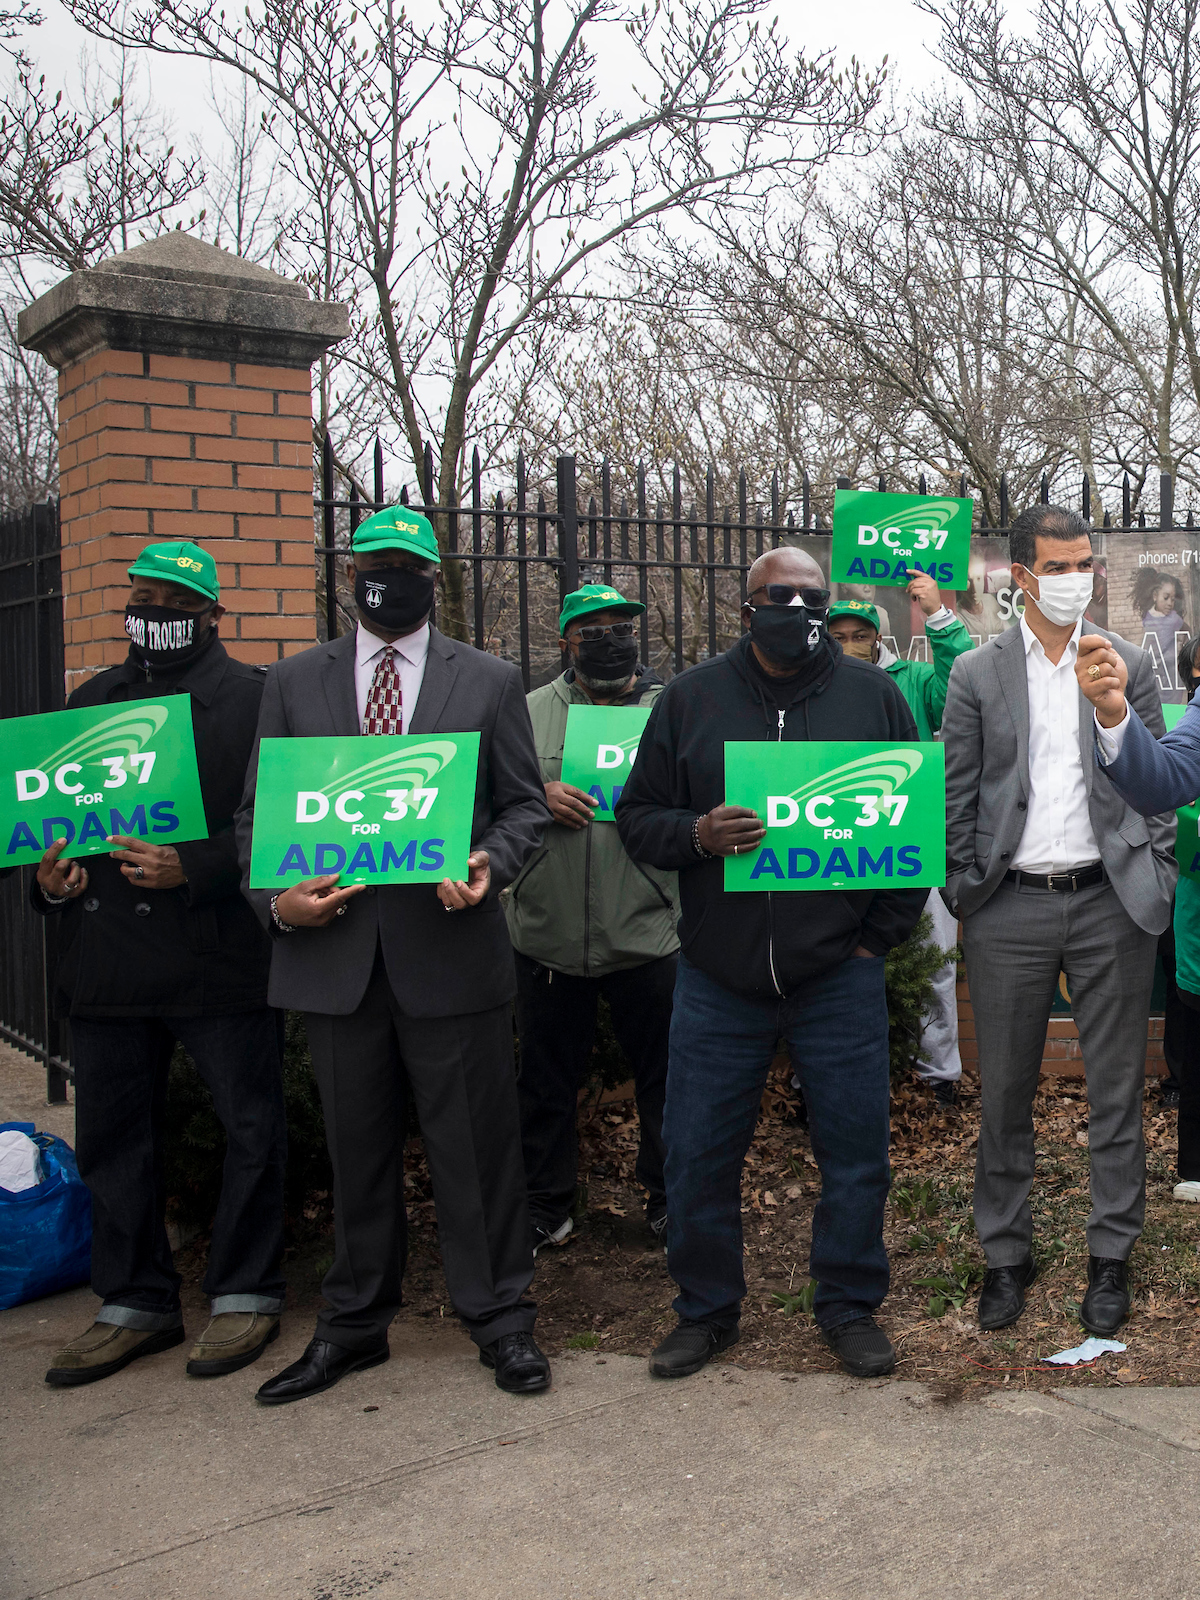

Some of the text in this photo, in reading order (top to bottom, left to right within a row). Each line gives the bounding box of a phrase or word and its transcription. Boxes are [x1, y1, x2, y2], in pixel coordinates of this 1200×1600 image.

[857, 525, 949, 550] DC 37
[892, 548, 912, 557] FOR
[1138, 550, 1178, 567] phone:
[846, 557, 954, 583] ADAMS
[147, 618, 194, 650] TROUBLE
[15, 751, 157, 802] DC 37
[75, 792, 104, 807] FOR
[296, 787, 439, 823] DC 37
[766, 794, 909, 828] DC 37
[6, 800, 180, 857] ADAMS
[351, 824, 381, 835] FOR
[823, 828, 853, 840] FOR
[276, 838, 446, 877] ADAMS
[749, 845, 923, 880] ADAMS
